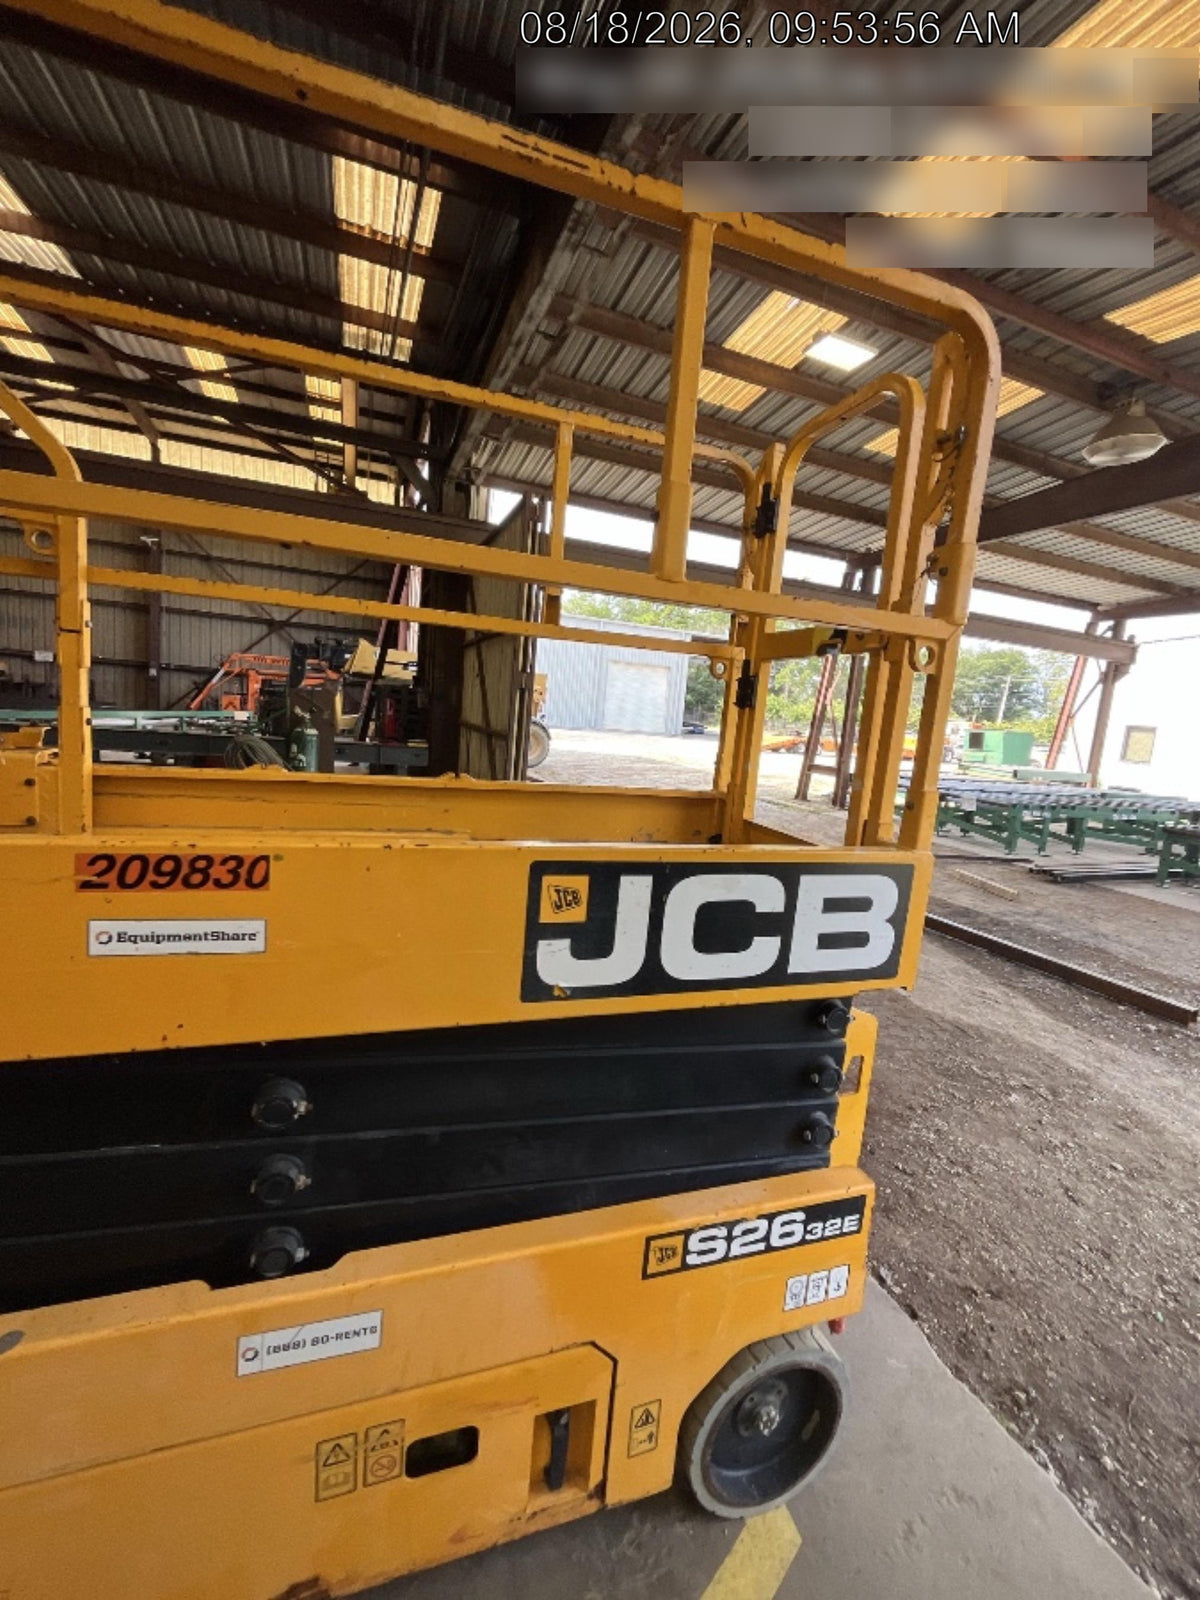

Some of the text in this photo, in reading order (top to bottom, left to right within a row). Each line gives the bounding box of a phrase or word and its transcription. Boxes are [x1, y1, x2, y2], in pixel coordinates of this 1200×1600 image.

[80, 853, 270, 890] 209830
[553, 888, 581, 911] JCB
[116, 931, 258, 945] EquipmentShare
[536, 874, 899, 988] JCB
